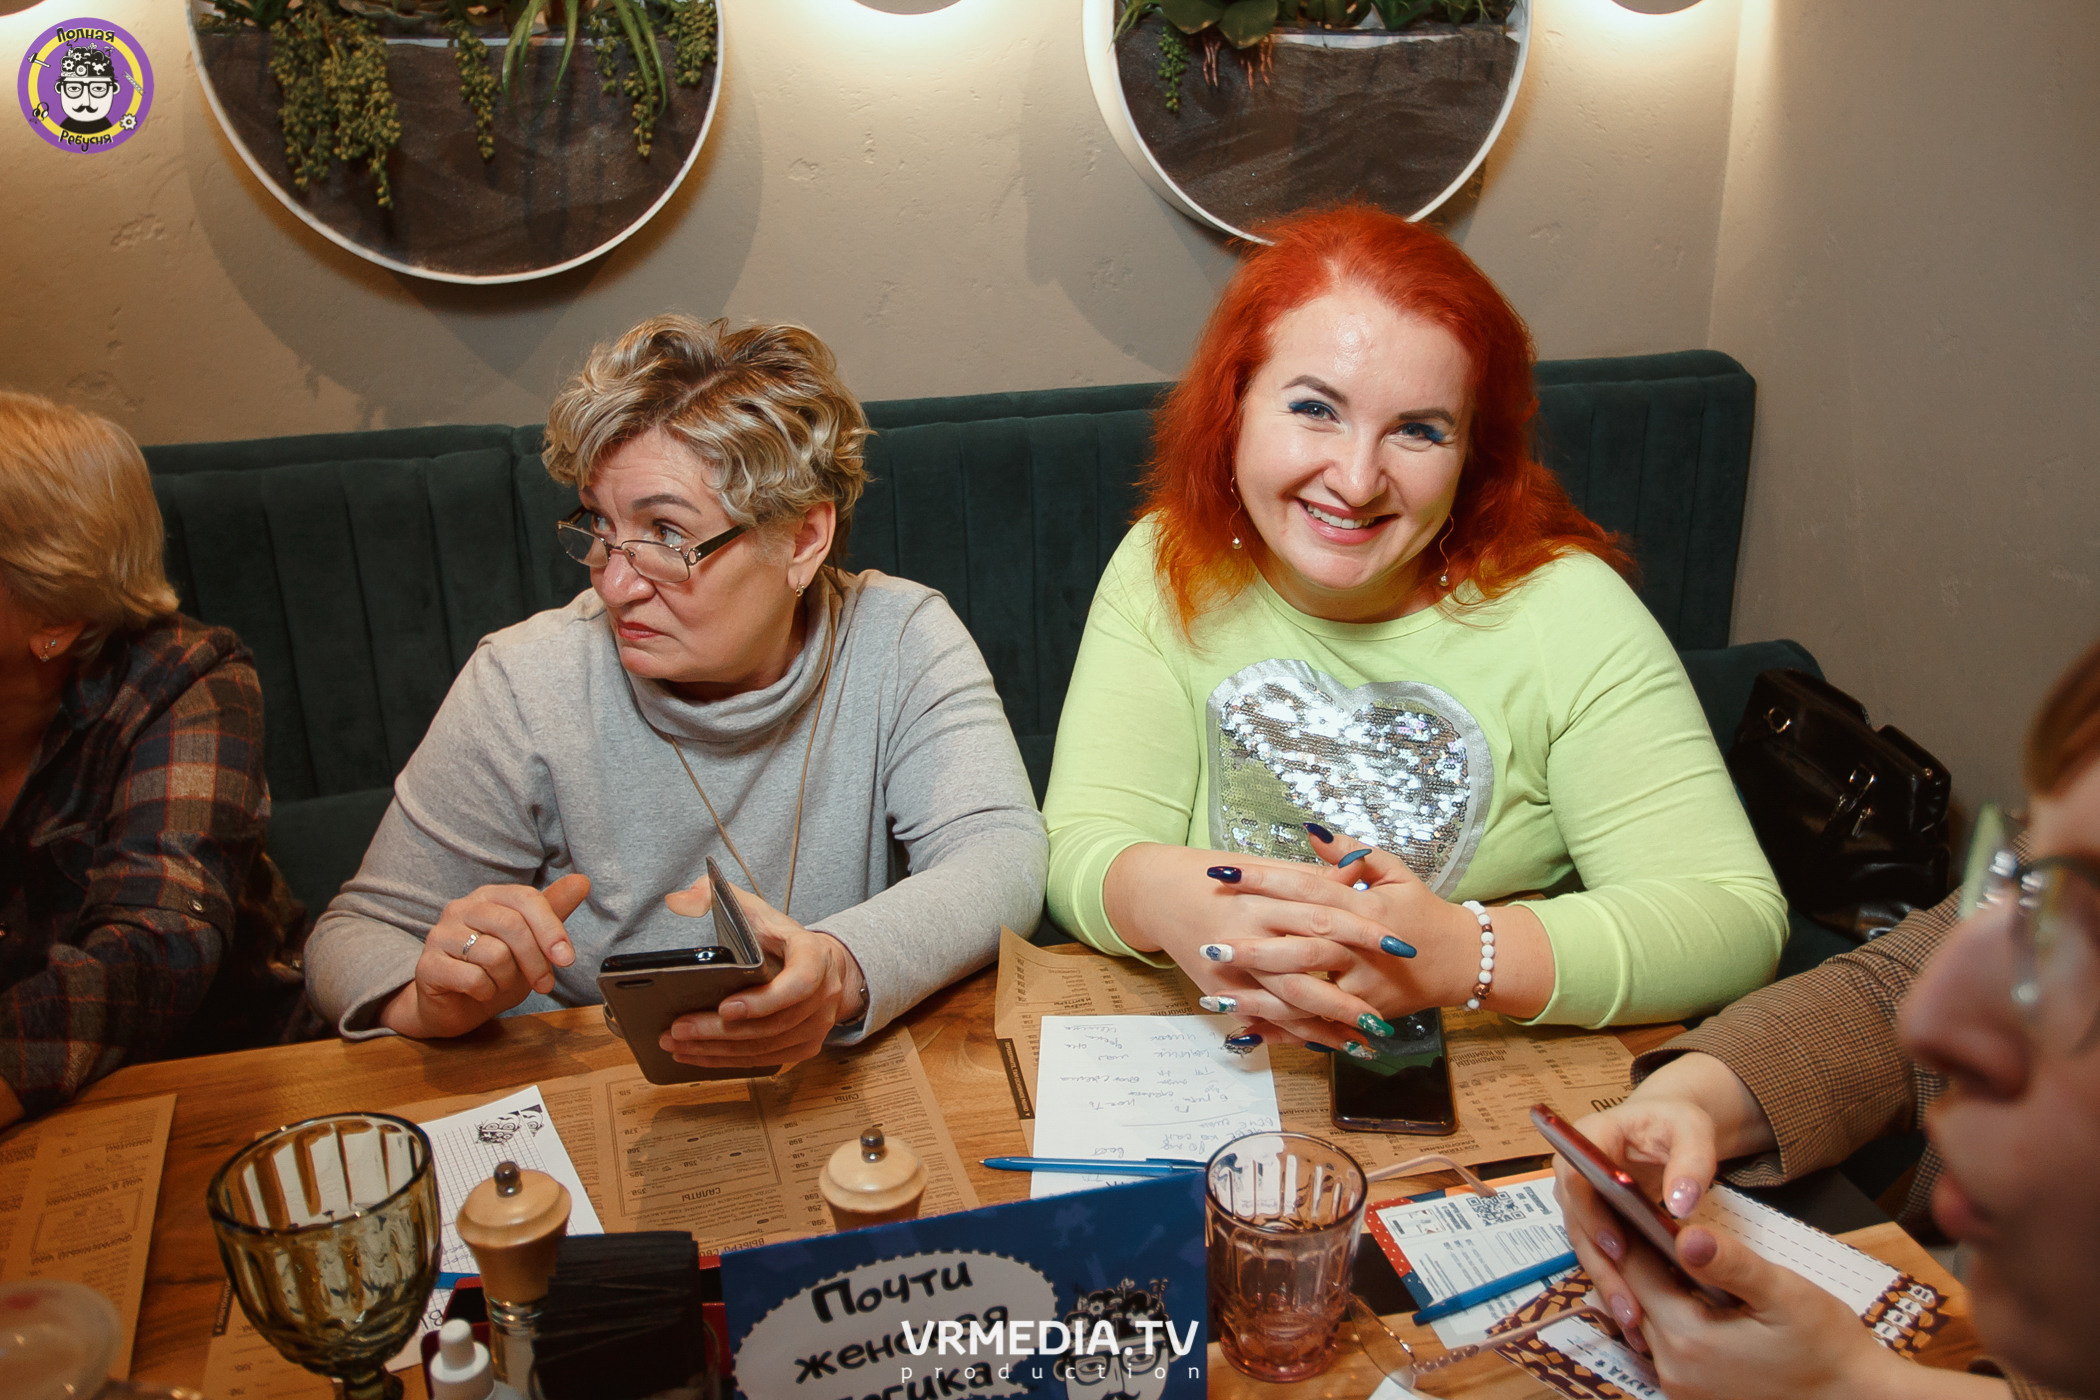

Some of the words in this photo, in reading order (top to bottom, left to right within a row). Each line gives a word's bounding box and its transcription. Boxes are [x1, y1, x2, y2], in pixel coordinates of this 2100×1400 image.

[834, 1093, 860, 1103] СУПЫ
[784, 1138, 803, 1147] 890.-
[681, 1187, 721, 1202] САЛАТЫ
[800, 1193, 820, 1201] 690.-
[802, 1204, 822, 1213] 250.-
[807, 1218, 827, 1227] 990.-
[811, 1262, 973, 1323] Почти
